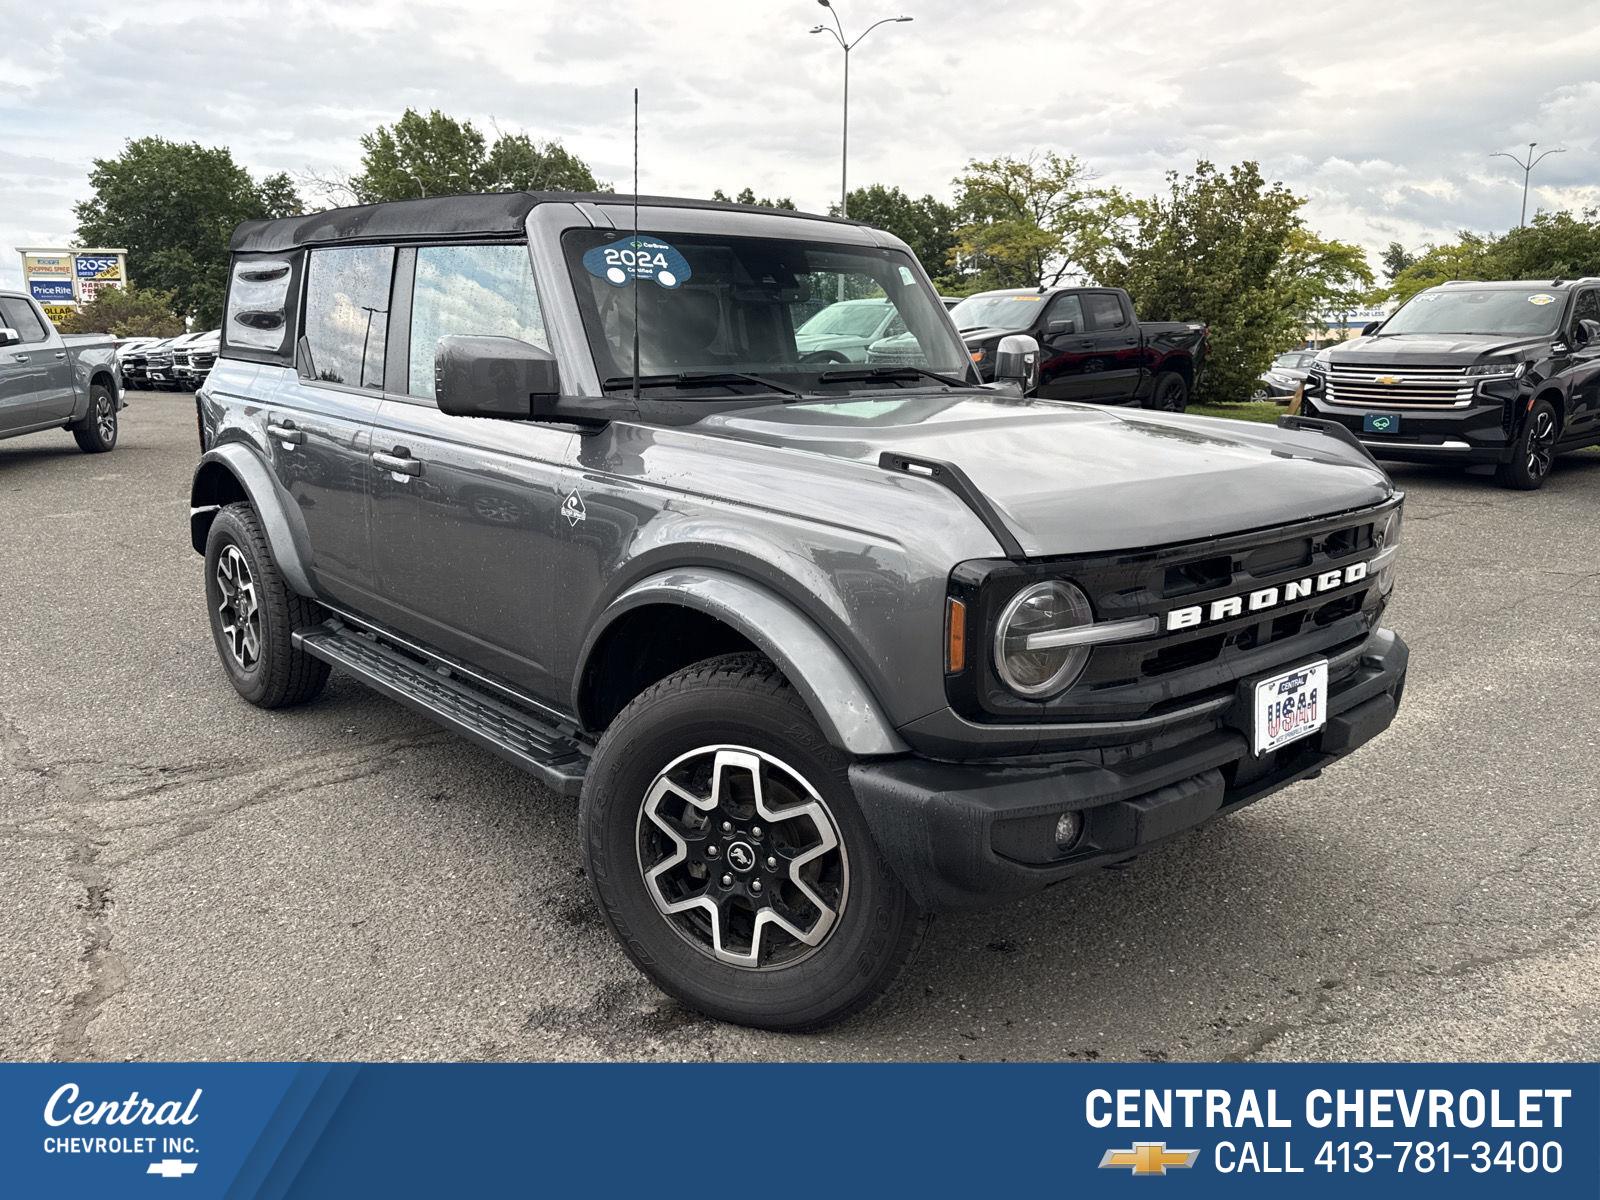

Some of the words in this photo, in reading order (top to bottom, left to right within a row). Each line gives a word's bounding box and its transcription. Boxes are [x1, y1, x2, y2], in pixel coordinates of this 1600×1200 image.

[604, 248, 669, 269] 2024
[77, 260, 117, 271] ROSS
[33, 286, 55, 294] Price
[55, 286, 72, 295] Rite
[44, 306, 72, 315] OLLAR
[1166, 561, 1367, 631] BRONCO
[1281, 676, 1305, 692] CENTRAL
